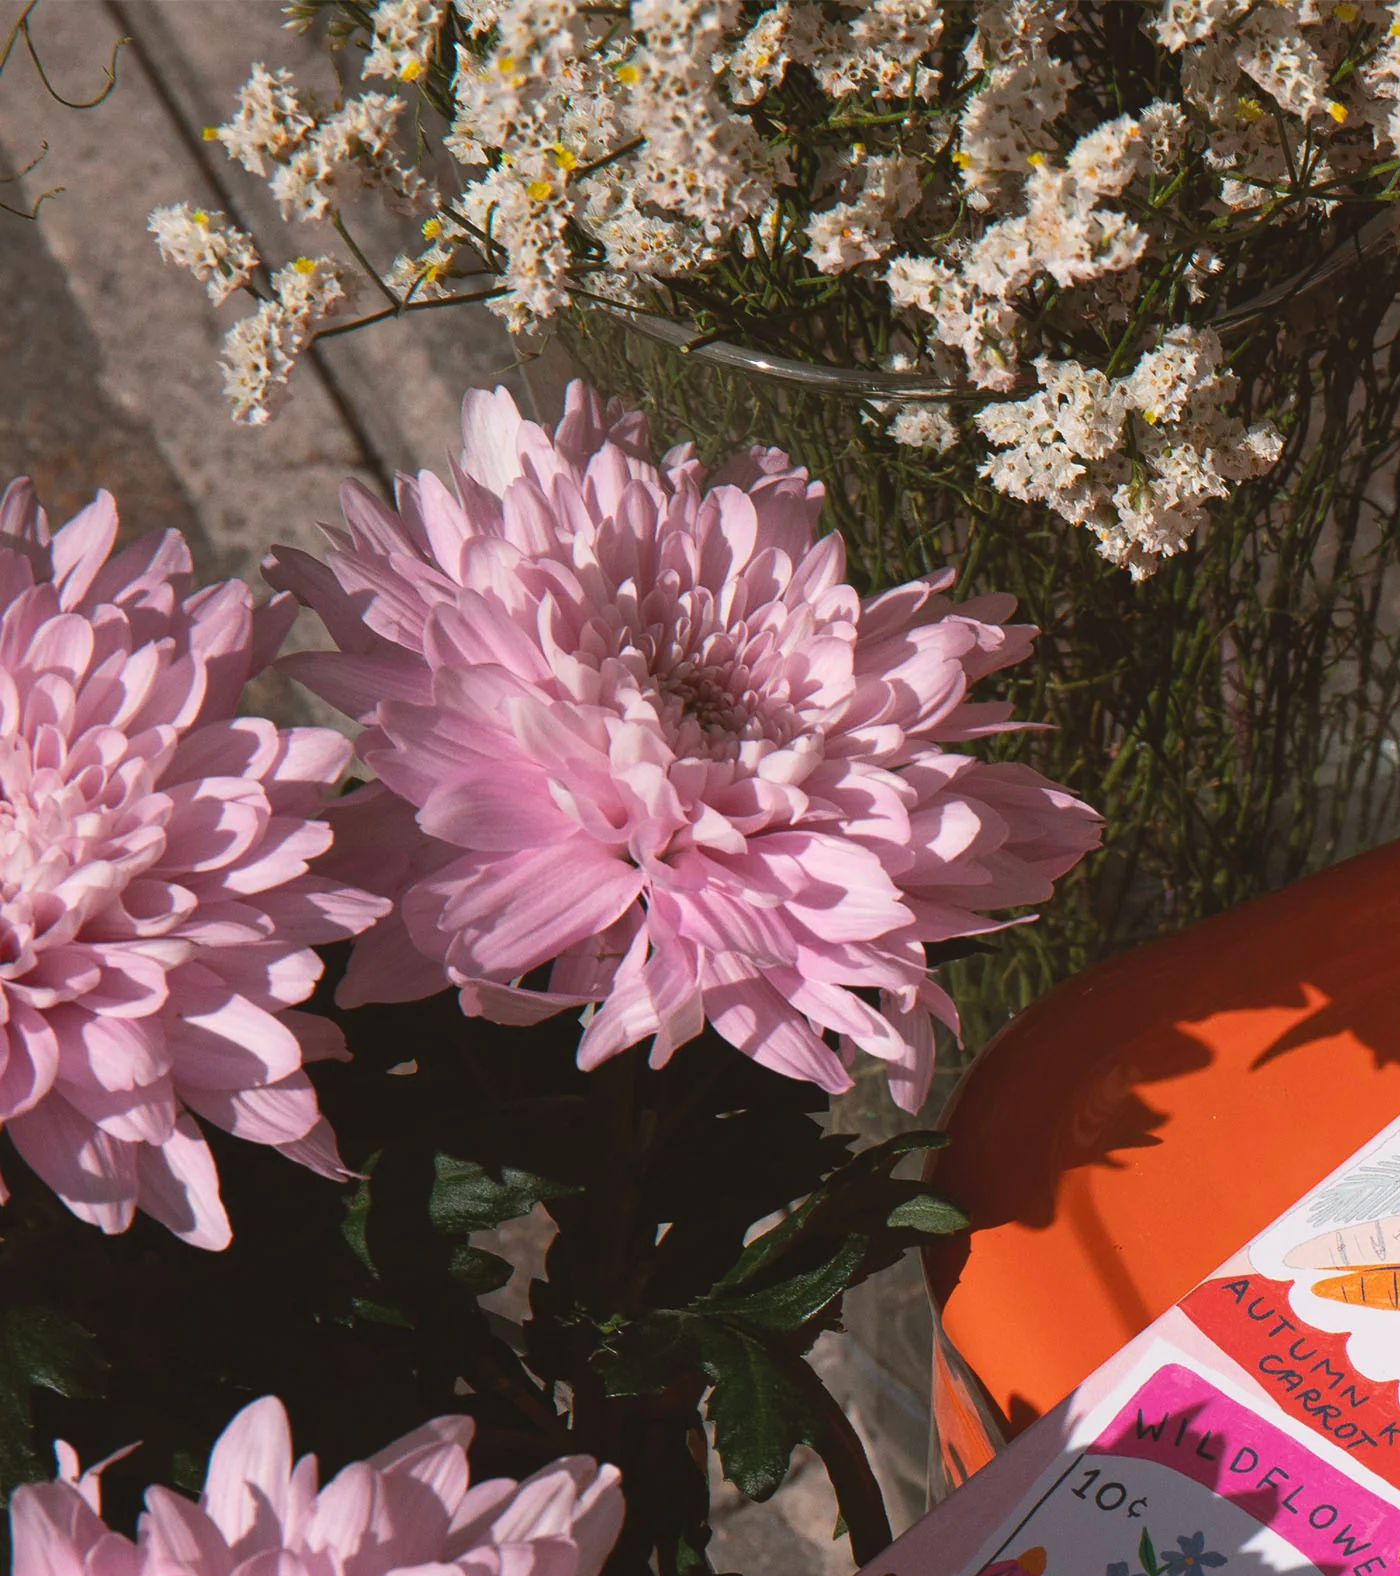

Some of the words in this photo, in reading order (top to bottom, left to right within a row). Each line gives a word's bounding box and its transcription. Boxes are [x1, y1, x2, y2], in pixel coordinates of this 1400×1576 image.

[1221, 1278, 1370, 1408] AUTUMN
[1257, 1354, 1378, 1449] CARROT
[1071, 1469, 1148, 1520] 10¢
